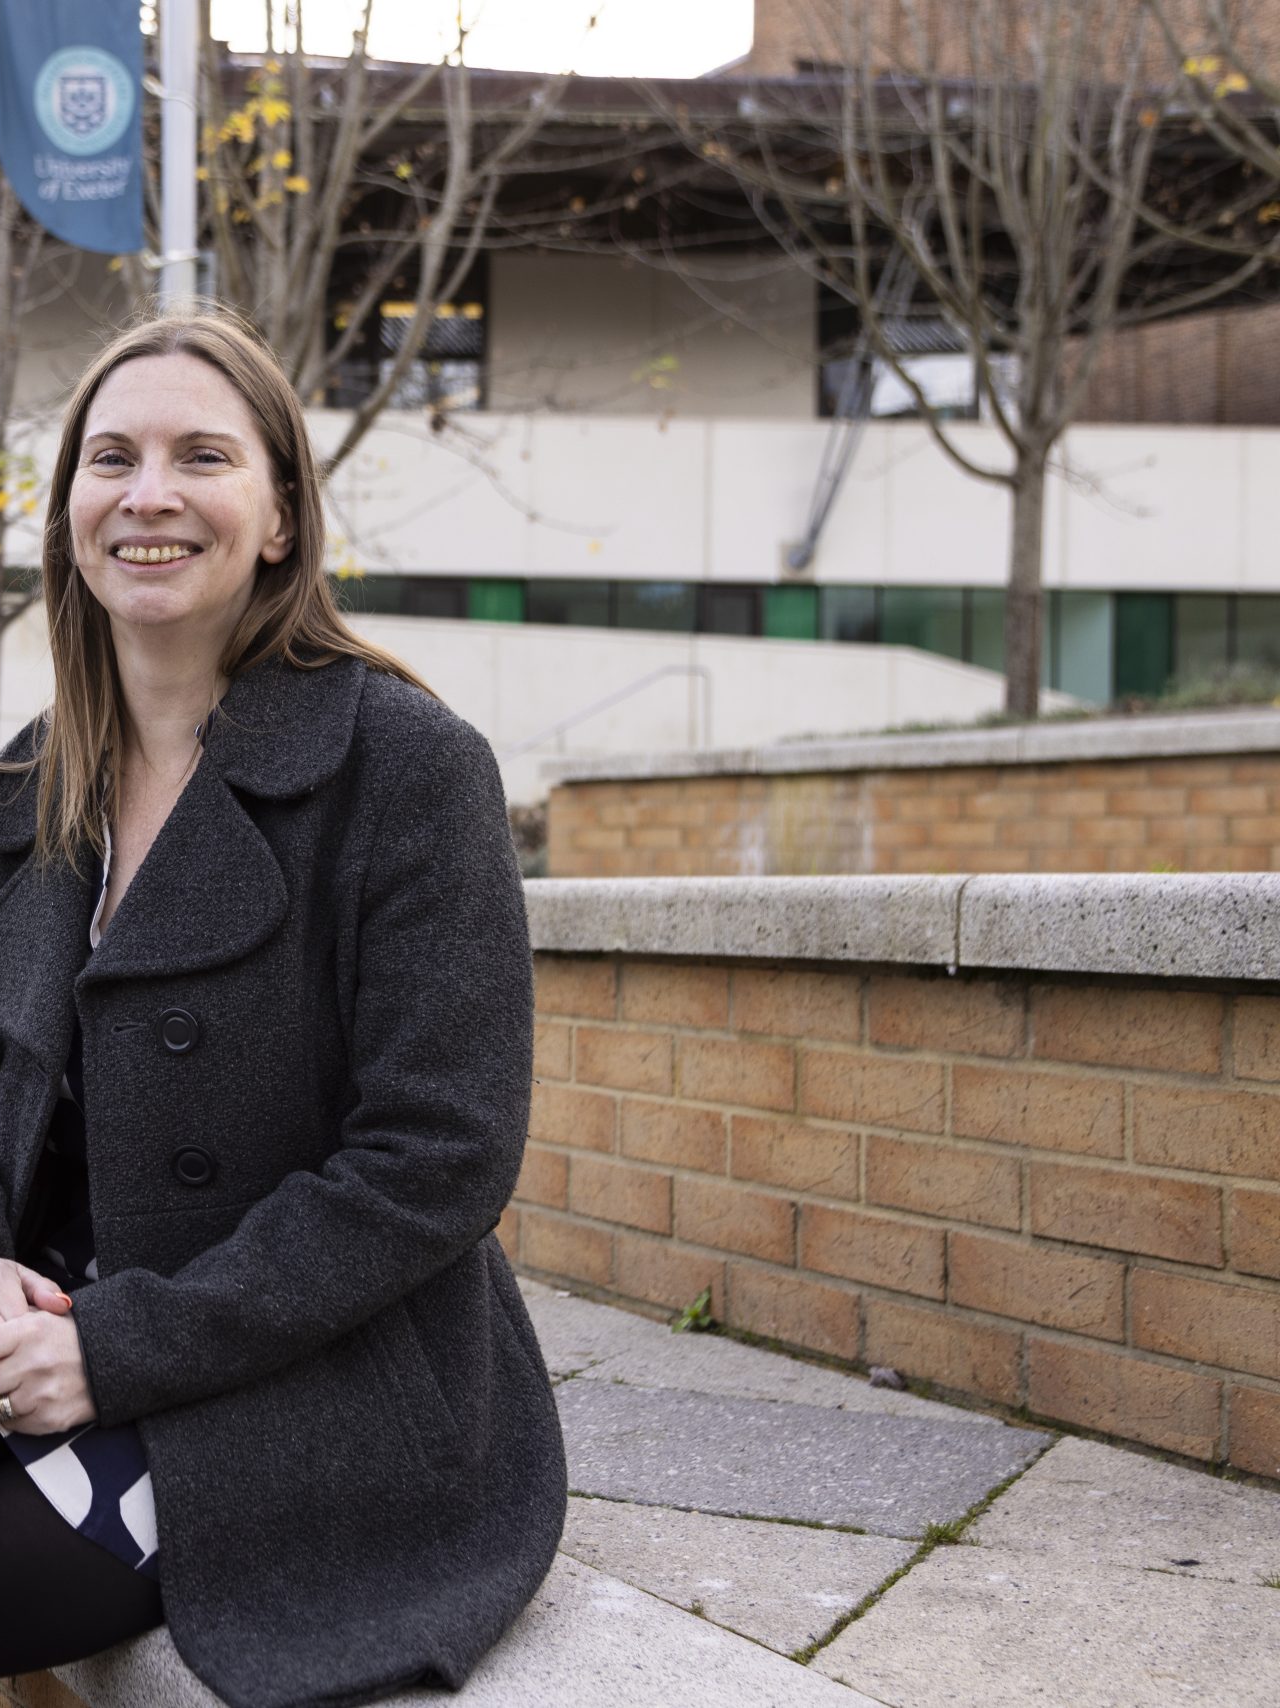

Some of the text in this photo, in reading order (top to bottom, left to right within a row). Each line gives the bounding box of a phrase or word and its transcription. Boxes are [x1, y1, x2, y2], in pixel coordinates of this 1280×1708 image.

[33, 154, 132, 181] University
[38, 179, 126, 203] of Exeter
